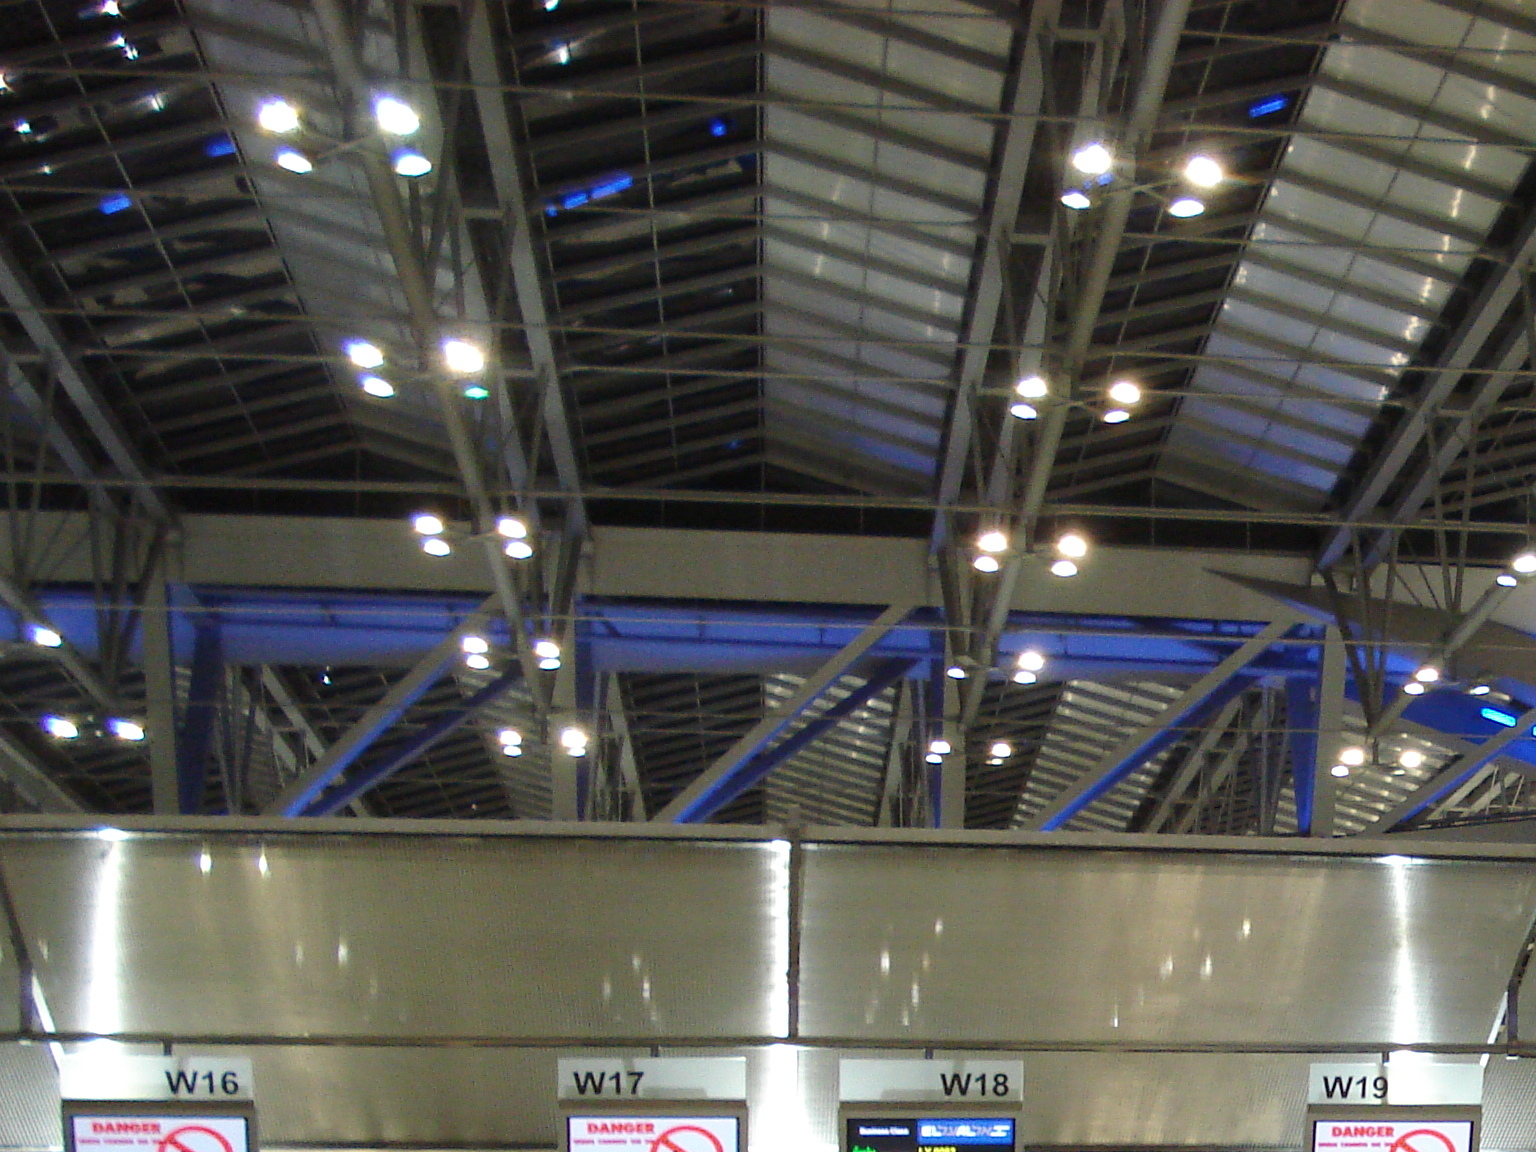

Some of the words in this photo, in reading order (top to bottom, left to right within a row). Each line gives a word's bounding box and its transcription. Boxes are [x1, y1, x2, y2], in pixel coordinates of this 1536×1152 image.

[165, 1070, 239, 1095] W16
[573, 1071, 644, 1095] W17
[940, 1073, 1009, 1097] W18
[1323, 1076, 1388, 1099] W19
[92, 1122, 161, 1134] DANGER
[587, 1122, 655, 1134] DANGER
[1331, 1126, 1395, 1138] DANGER
